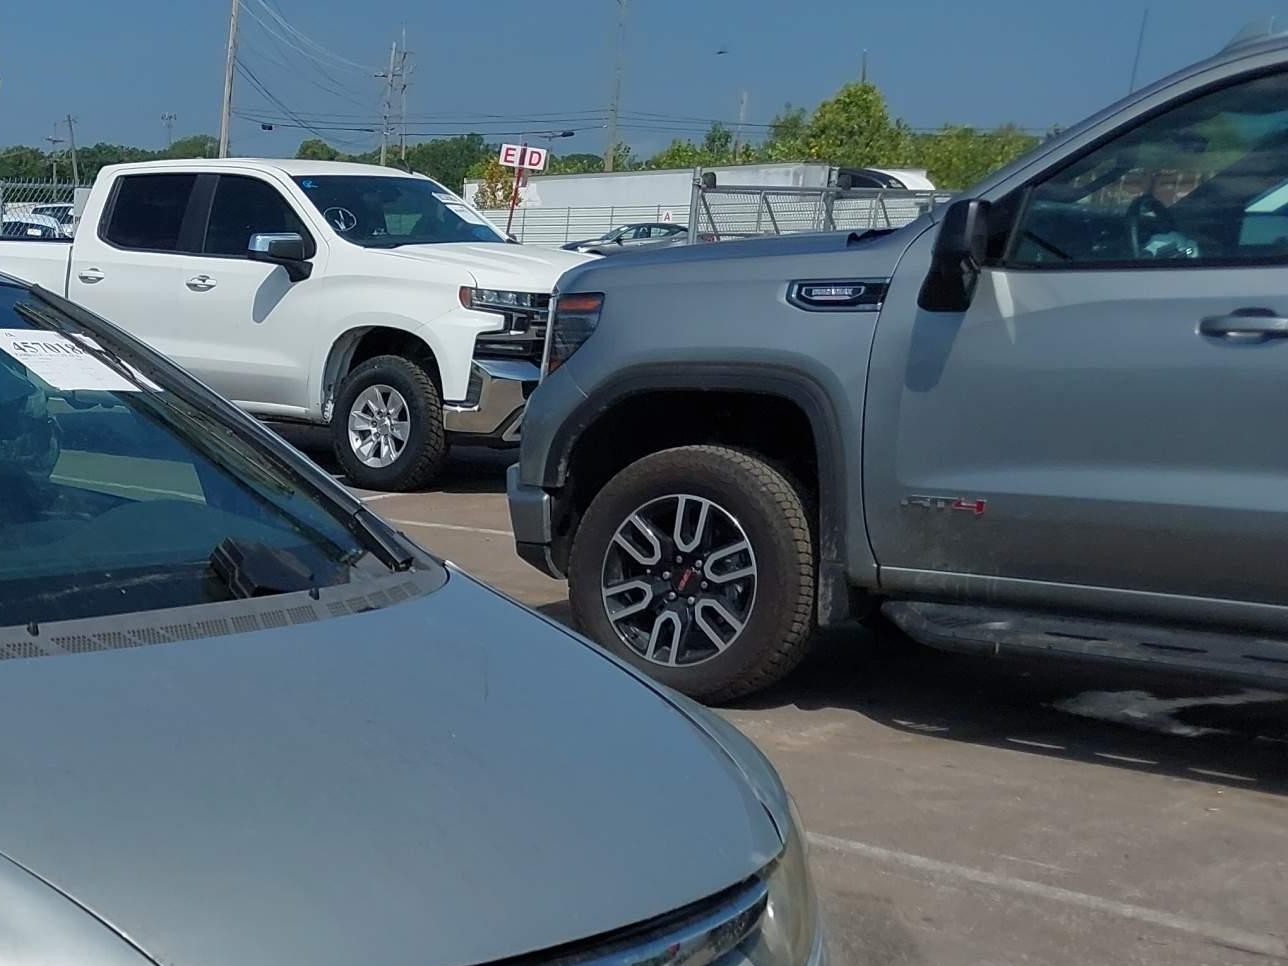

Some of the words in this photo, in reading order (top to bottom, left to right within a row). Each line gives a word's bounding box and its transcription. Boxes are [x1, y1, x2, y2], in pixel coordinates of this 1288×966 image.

[503, 147, 517, 164] E
[528, 150, 542, 167] D
[663, 211, 671, 222] A
